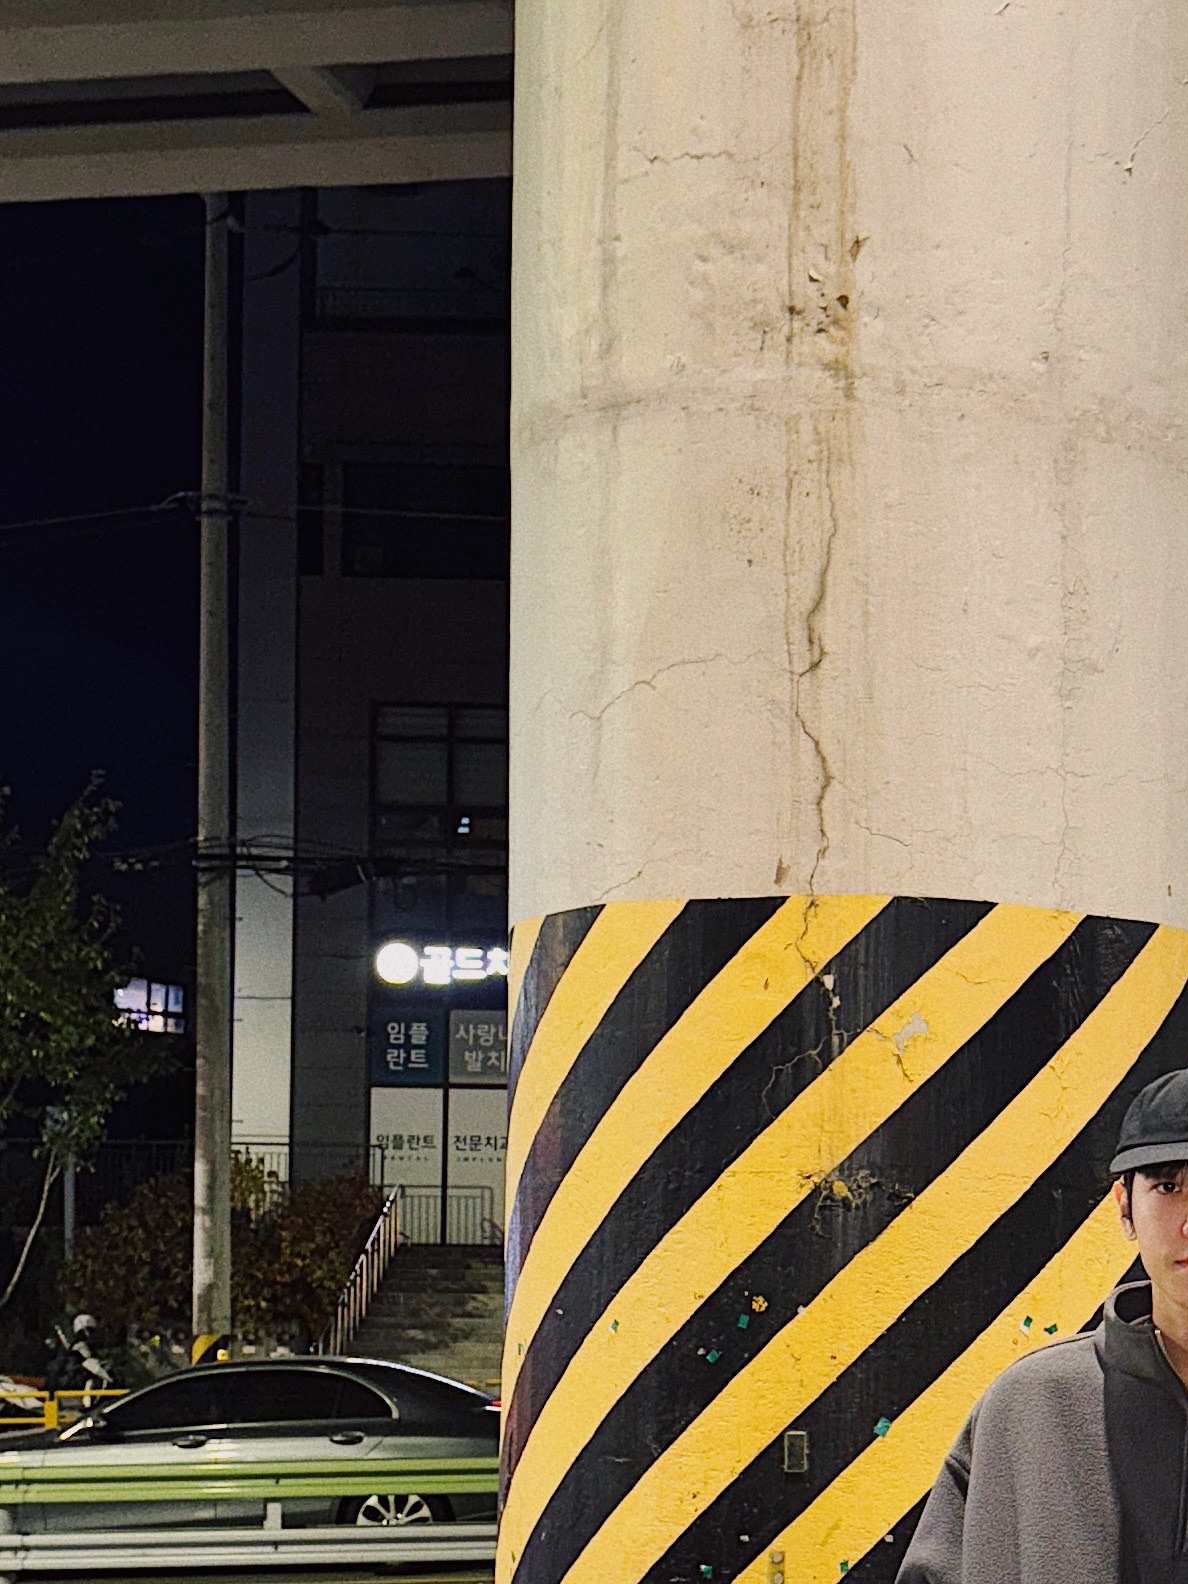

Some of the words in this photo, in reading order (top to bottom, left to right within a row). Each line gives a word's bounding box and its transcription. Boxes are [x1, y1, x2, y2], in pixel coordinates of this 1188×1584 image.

[386, 1021, 429, 1044] 임플
[386, 1048, 429, 1071] 란트
[464, 1049, 507, 1072] 발치
[376, 1134, 437, 1151] 임플란트
